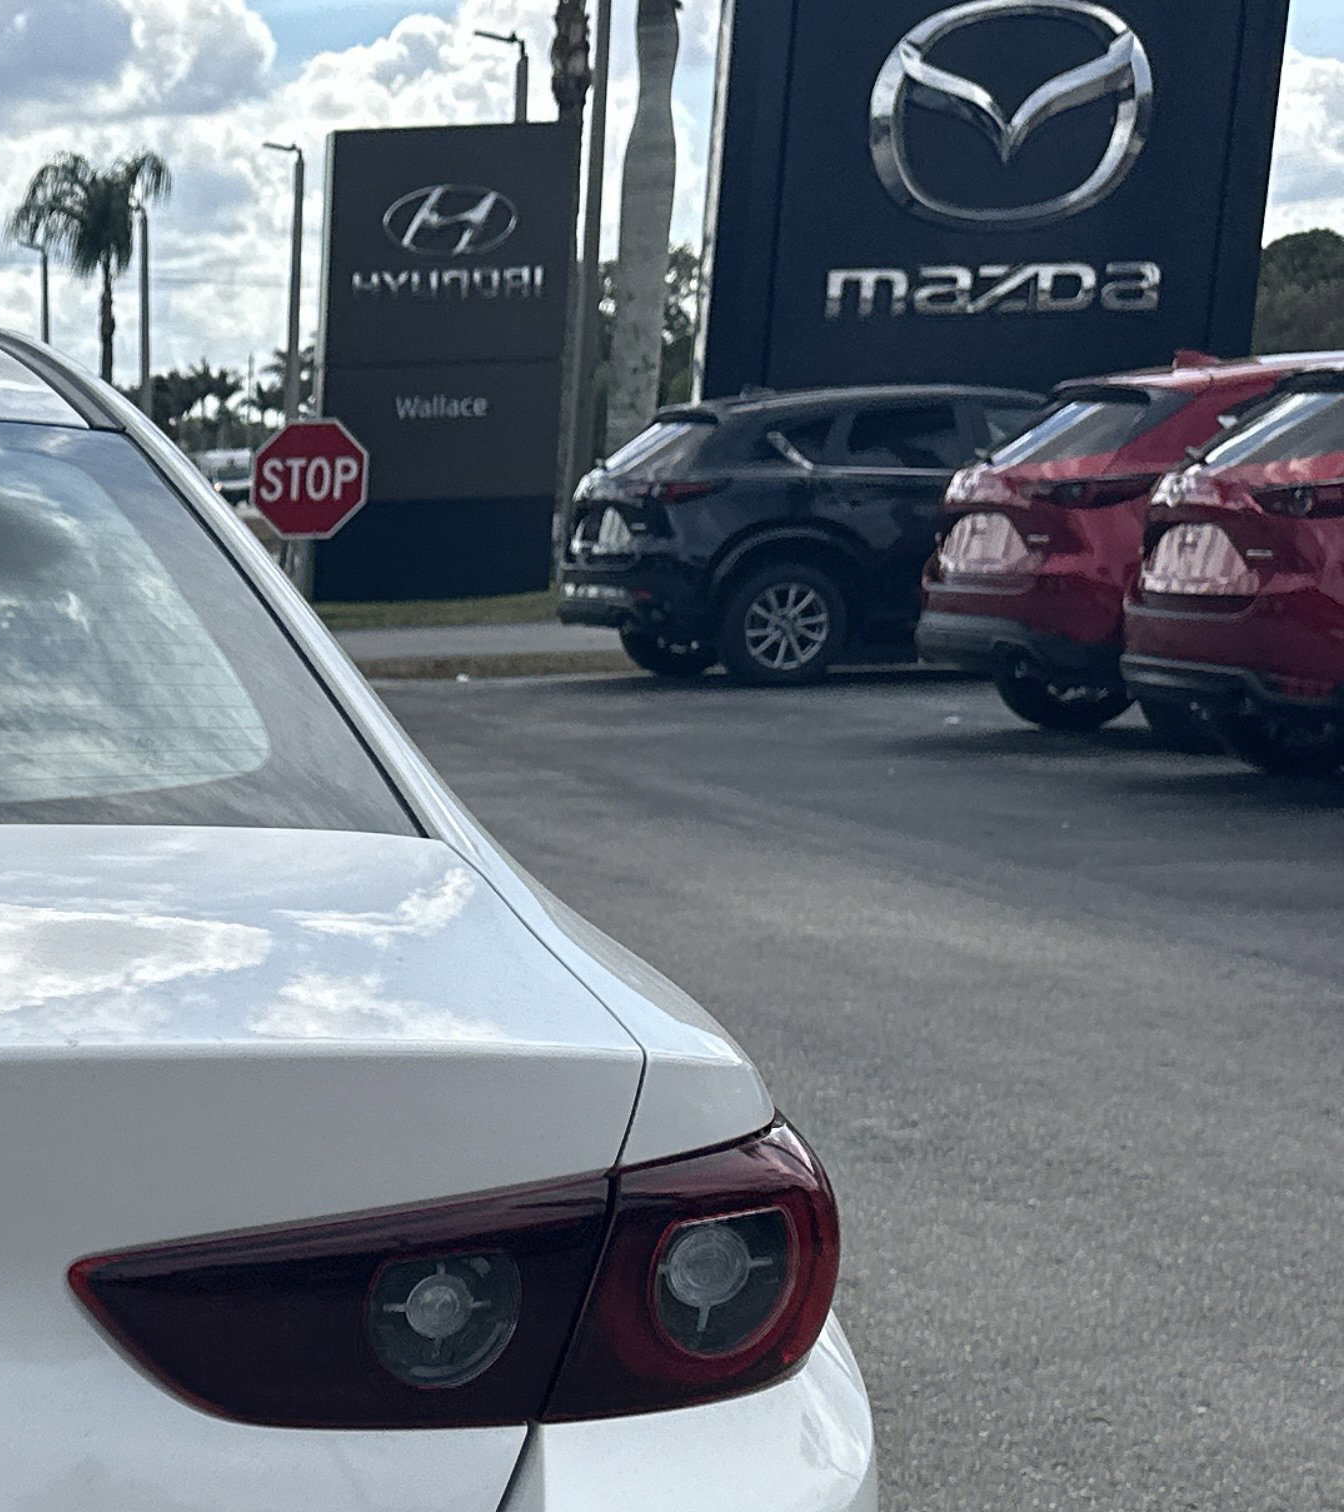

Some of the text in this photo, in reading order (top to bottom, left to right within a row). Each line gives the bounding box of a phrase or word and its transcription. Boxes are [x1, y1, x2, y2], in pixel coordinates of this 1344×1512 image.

[351, 264, 545, 300] HYUNDAI
[395, 393, 489, 419] Wallace
[259, 456, 359, 503] STOP
